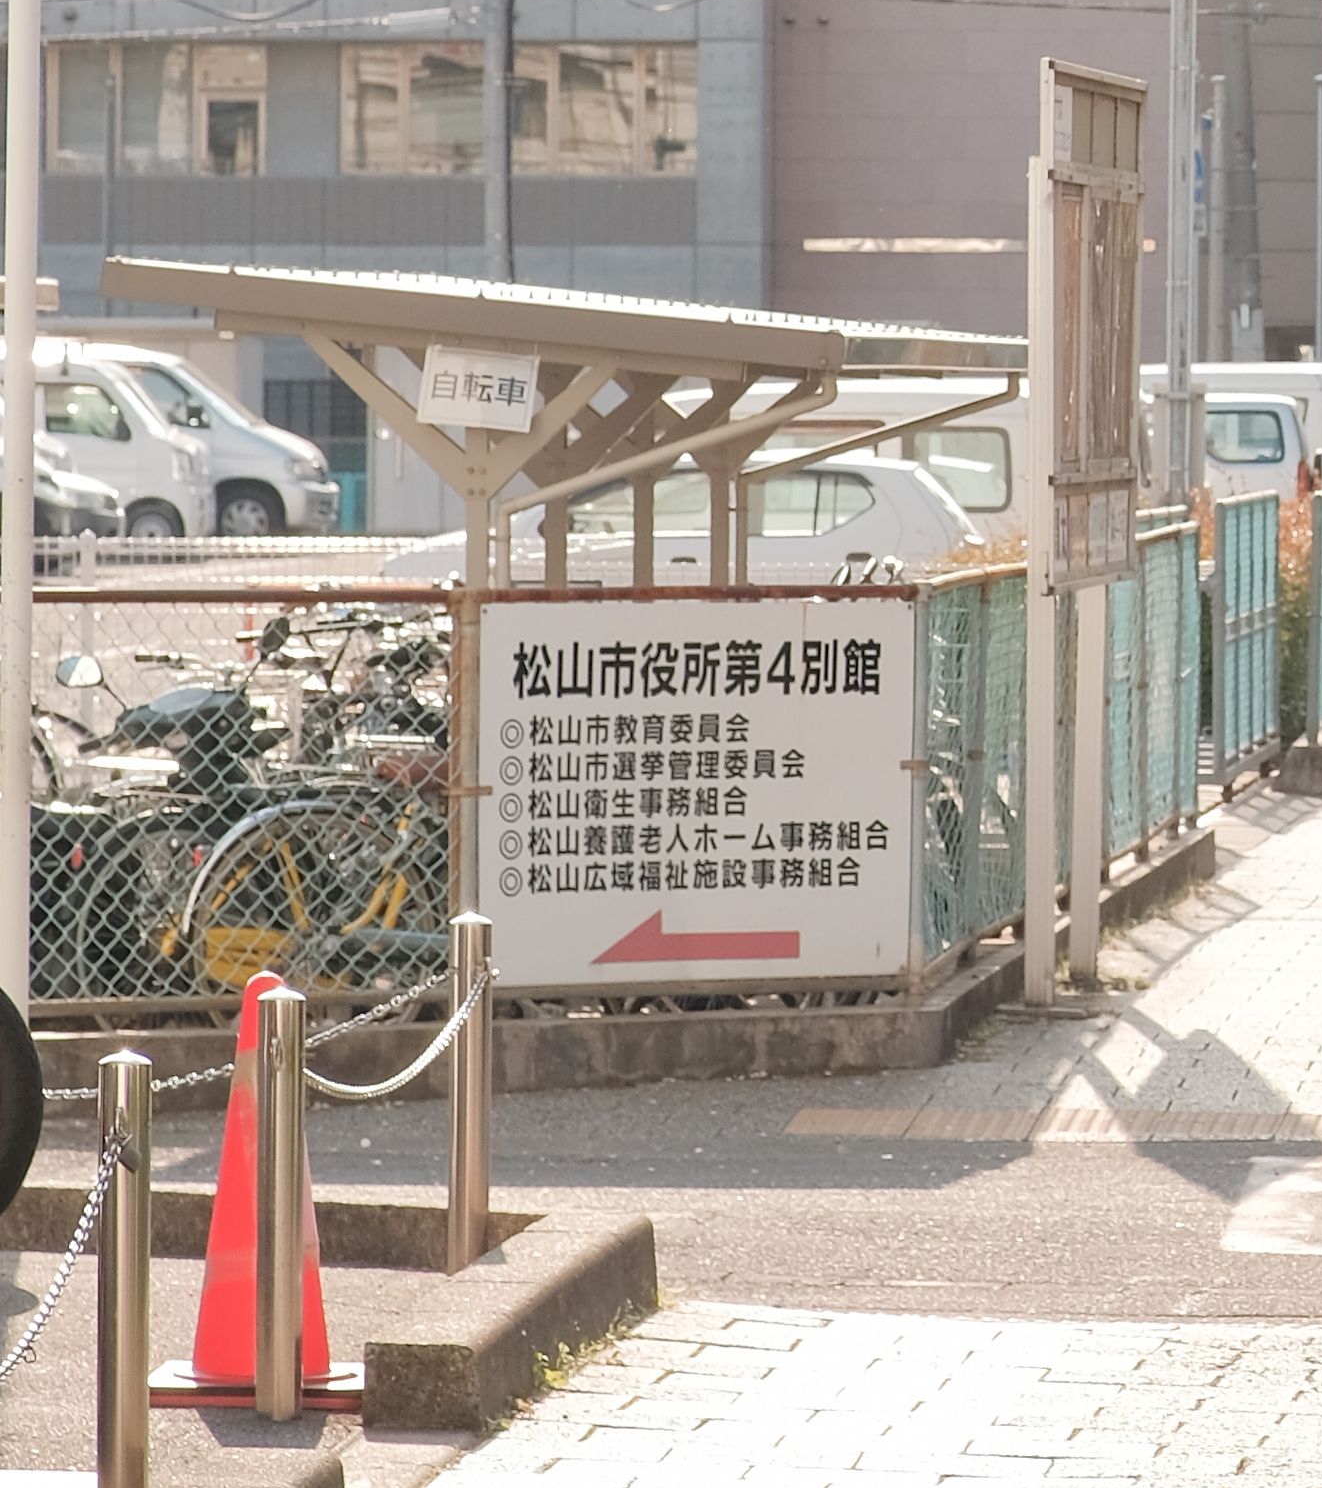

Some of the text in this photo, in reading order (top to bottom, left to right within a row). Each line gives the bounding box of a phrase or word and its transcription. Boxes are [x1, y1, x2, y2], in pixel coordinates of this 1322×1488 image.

[432, 370, 528, 407] 自転車
[513, 638, 882, 699] 松山市役所第4別館
